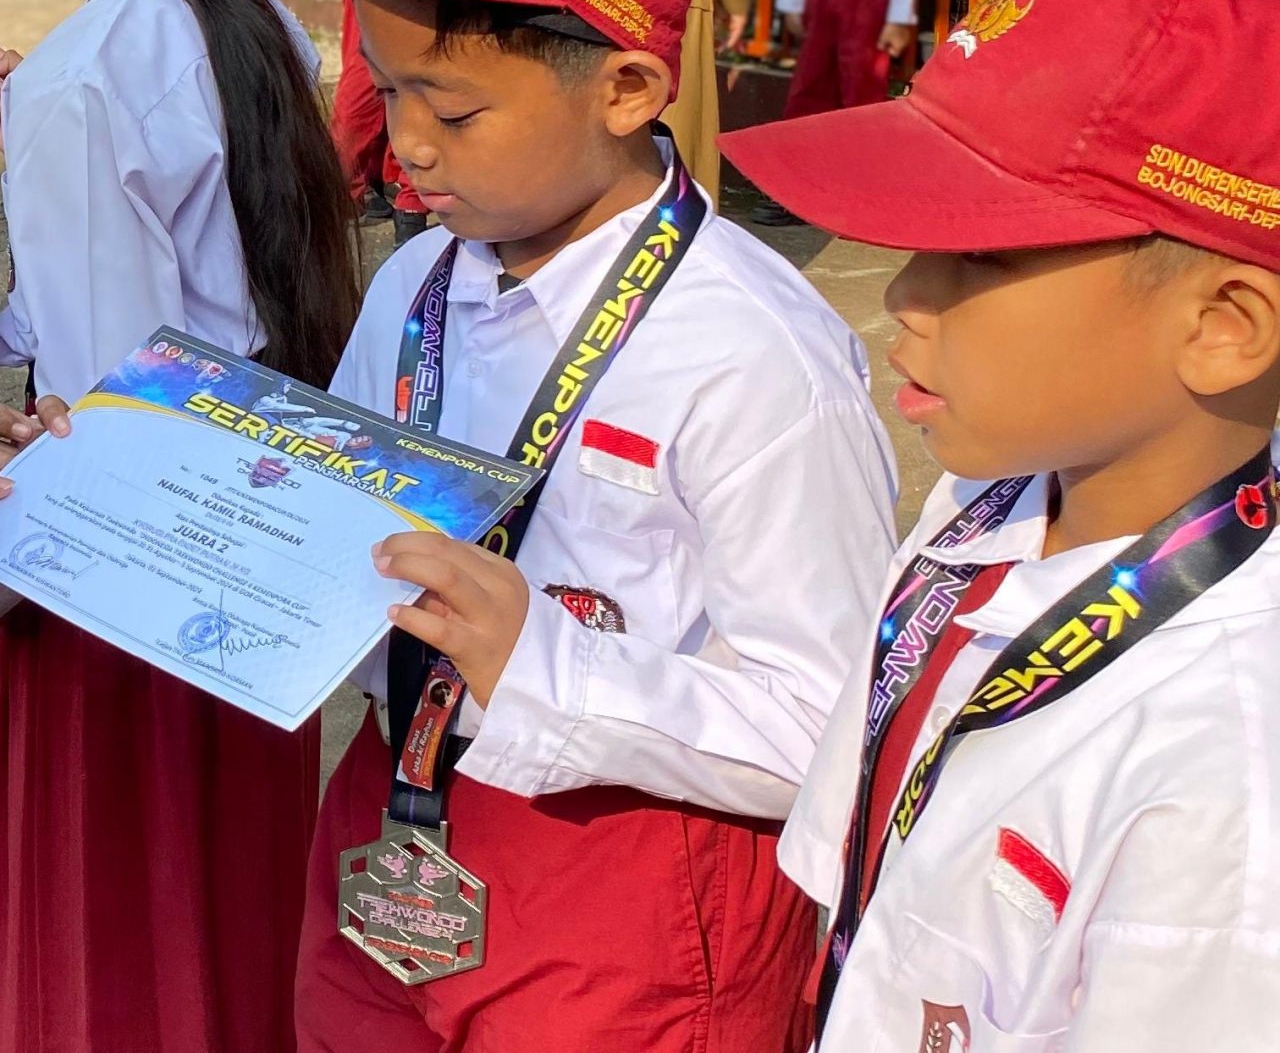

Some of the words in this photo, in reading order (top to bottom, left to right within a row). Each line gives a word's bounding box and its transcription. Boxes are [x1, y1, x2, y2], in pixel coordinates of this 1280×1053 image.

[182, 391, 422, 500] SERTIFIKAT
[395, 437, 487, 475] KEMENPORA
[487, 469, 521, 486] CUP
[199, 473, 218, 485] 1049
[294, 456, 398, 502] PENGHARGAAN
[156, 478, 199, 503] NAUFAL
[200, 498, 236, 519] KAMIL
[237, 514, 304, 546] RAMADHAN
[172, 524, 216, 549] JUARA
[215, 542, 229, 554] 2
[408, 729, 420, 754] Dimas
[421, 717, 434, 745] Rayhan
